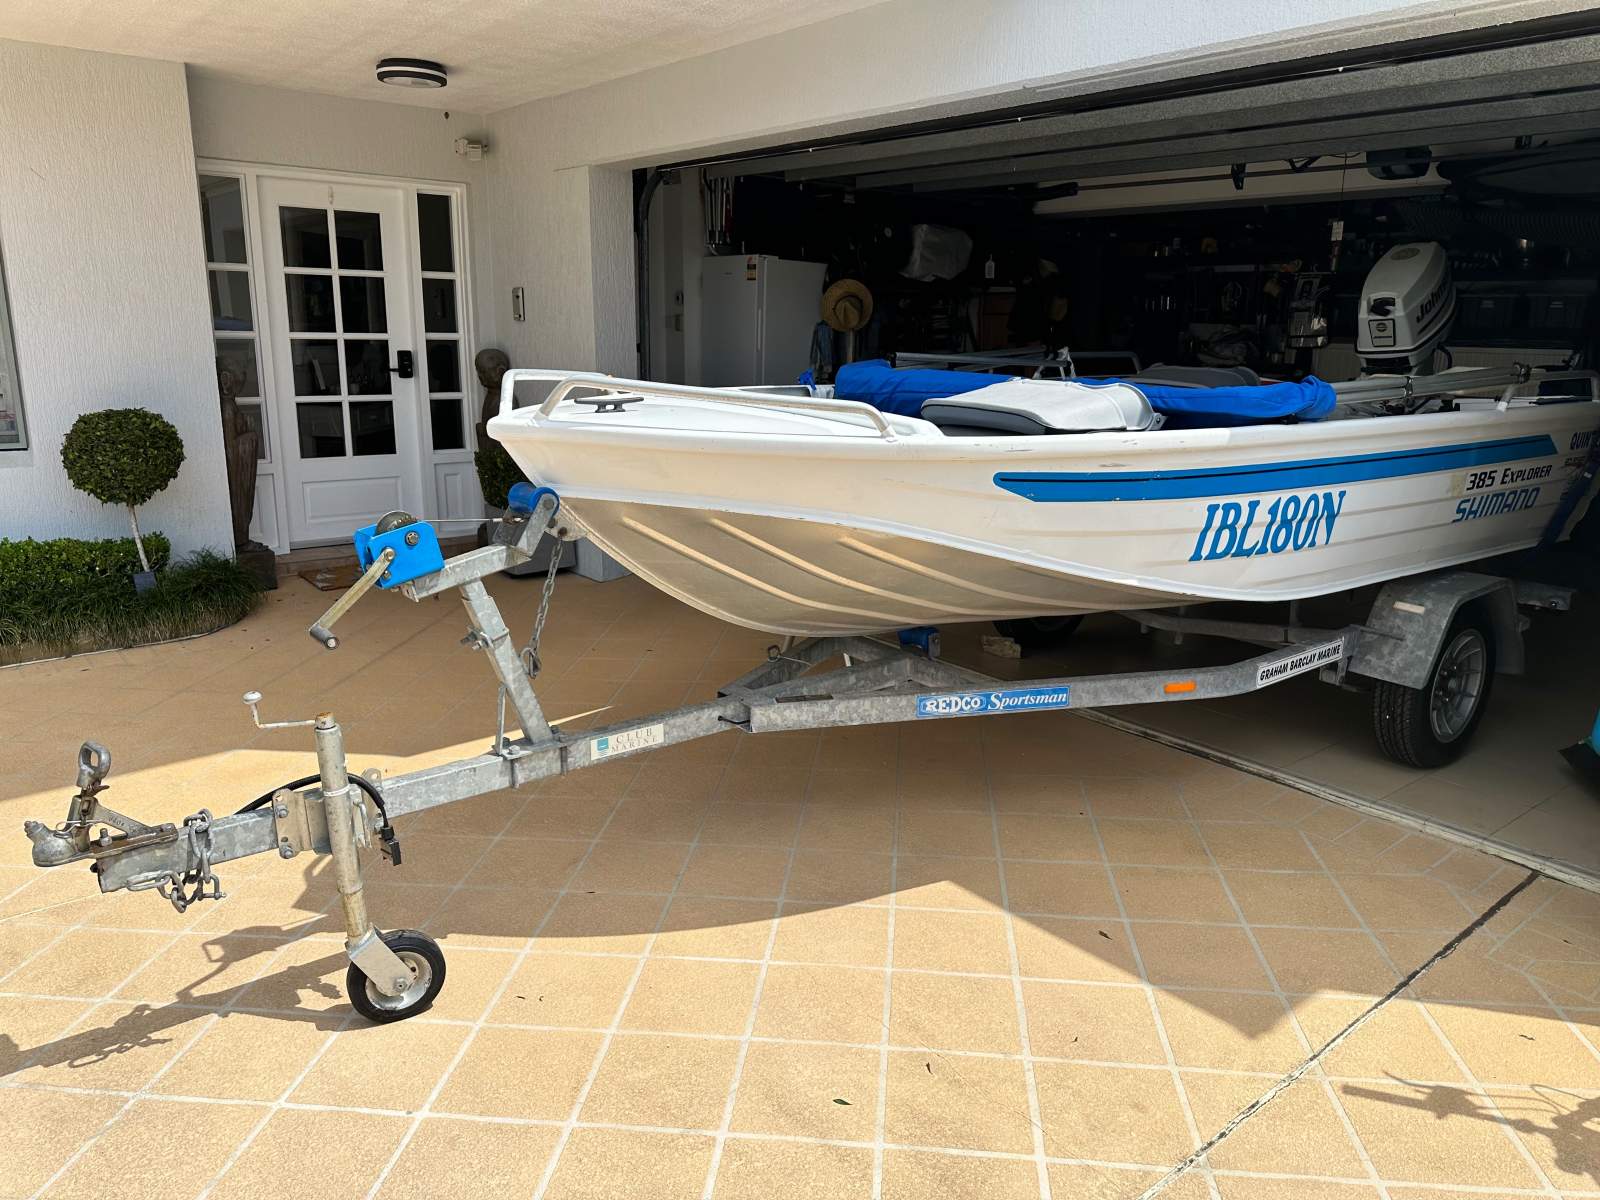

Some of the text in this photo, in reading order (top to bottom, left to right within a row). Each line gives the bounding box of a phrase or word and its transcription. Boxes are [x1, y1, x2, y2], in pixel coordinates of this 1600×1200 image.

[1466, 470, 1497, 491] 385
[1454, 487, 1541, 522] SHIMANO
[1188, 490, 1347, 562] IBL180N
[1260, 644, 1341, 681] GRAHAM BARCLAY MARINE
[925, 692, 1066, 712] REDCO Sportsman
